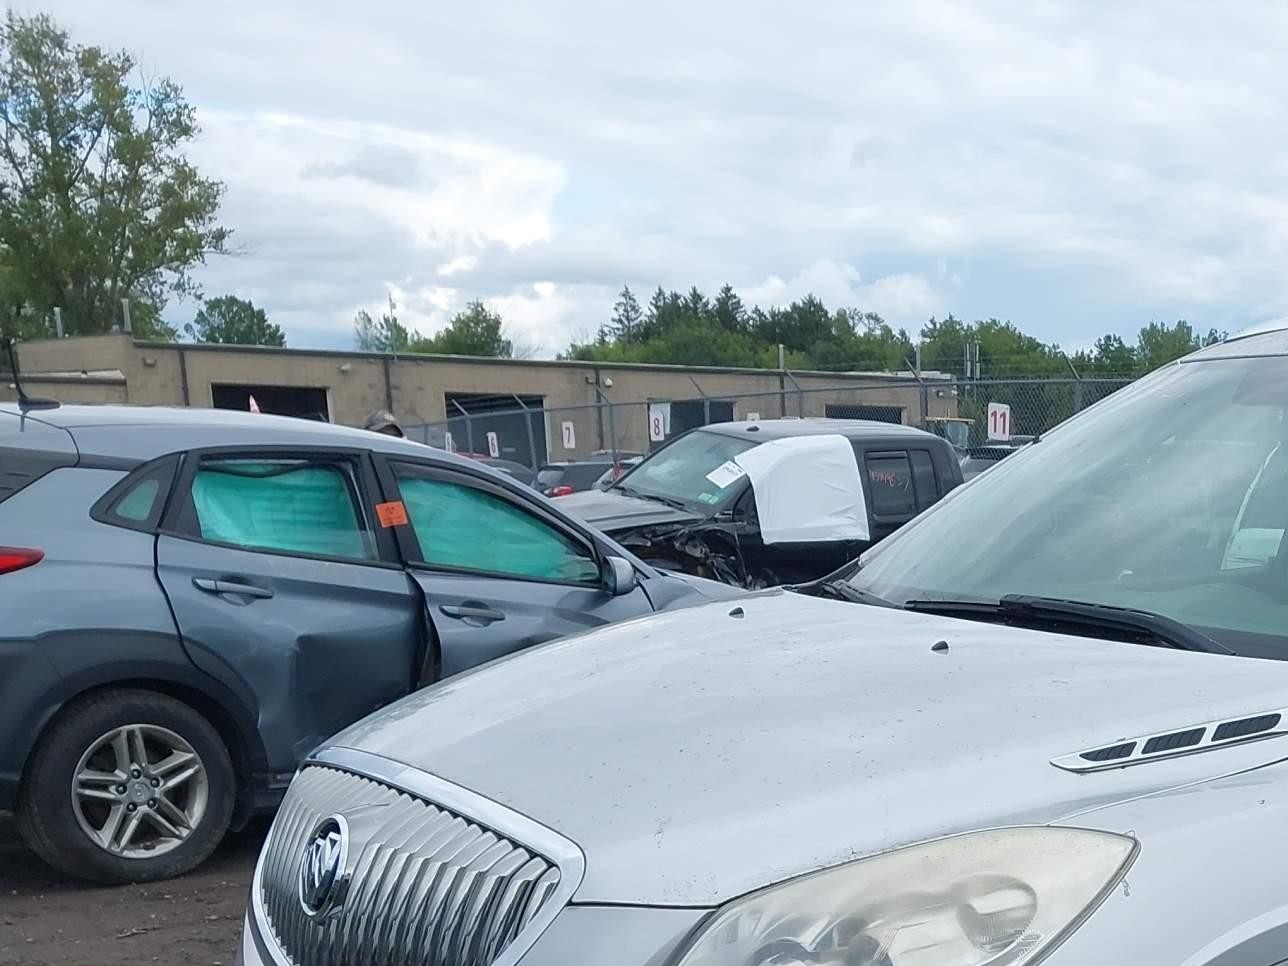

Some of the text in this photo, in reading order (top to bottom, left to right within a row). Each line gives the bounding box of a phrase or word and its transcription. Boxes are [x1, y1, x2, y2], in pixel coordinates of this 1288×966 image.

[653, 417, 661, 436] 8
[990, 410, 1007, 435] 11
[564, 426, 571, 444] 7
